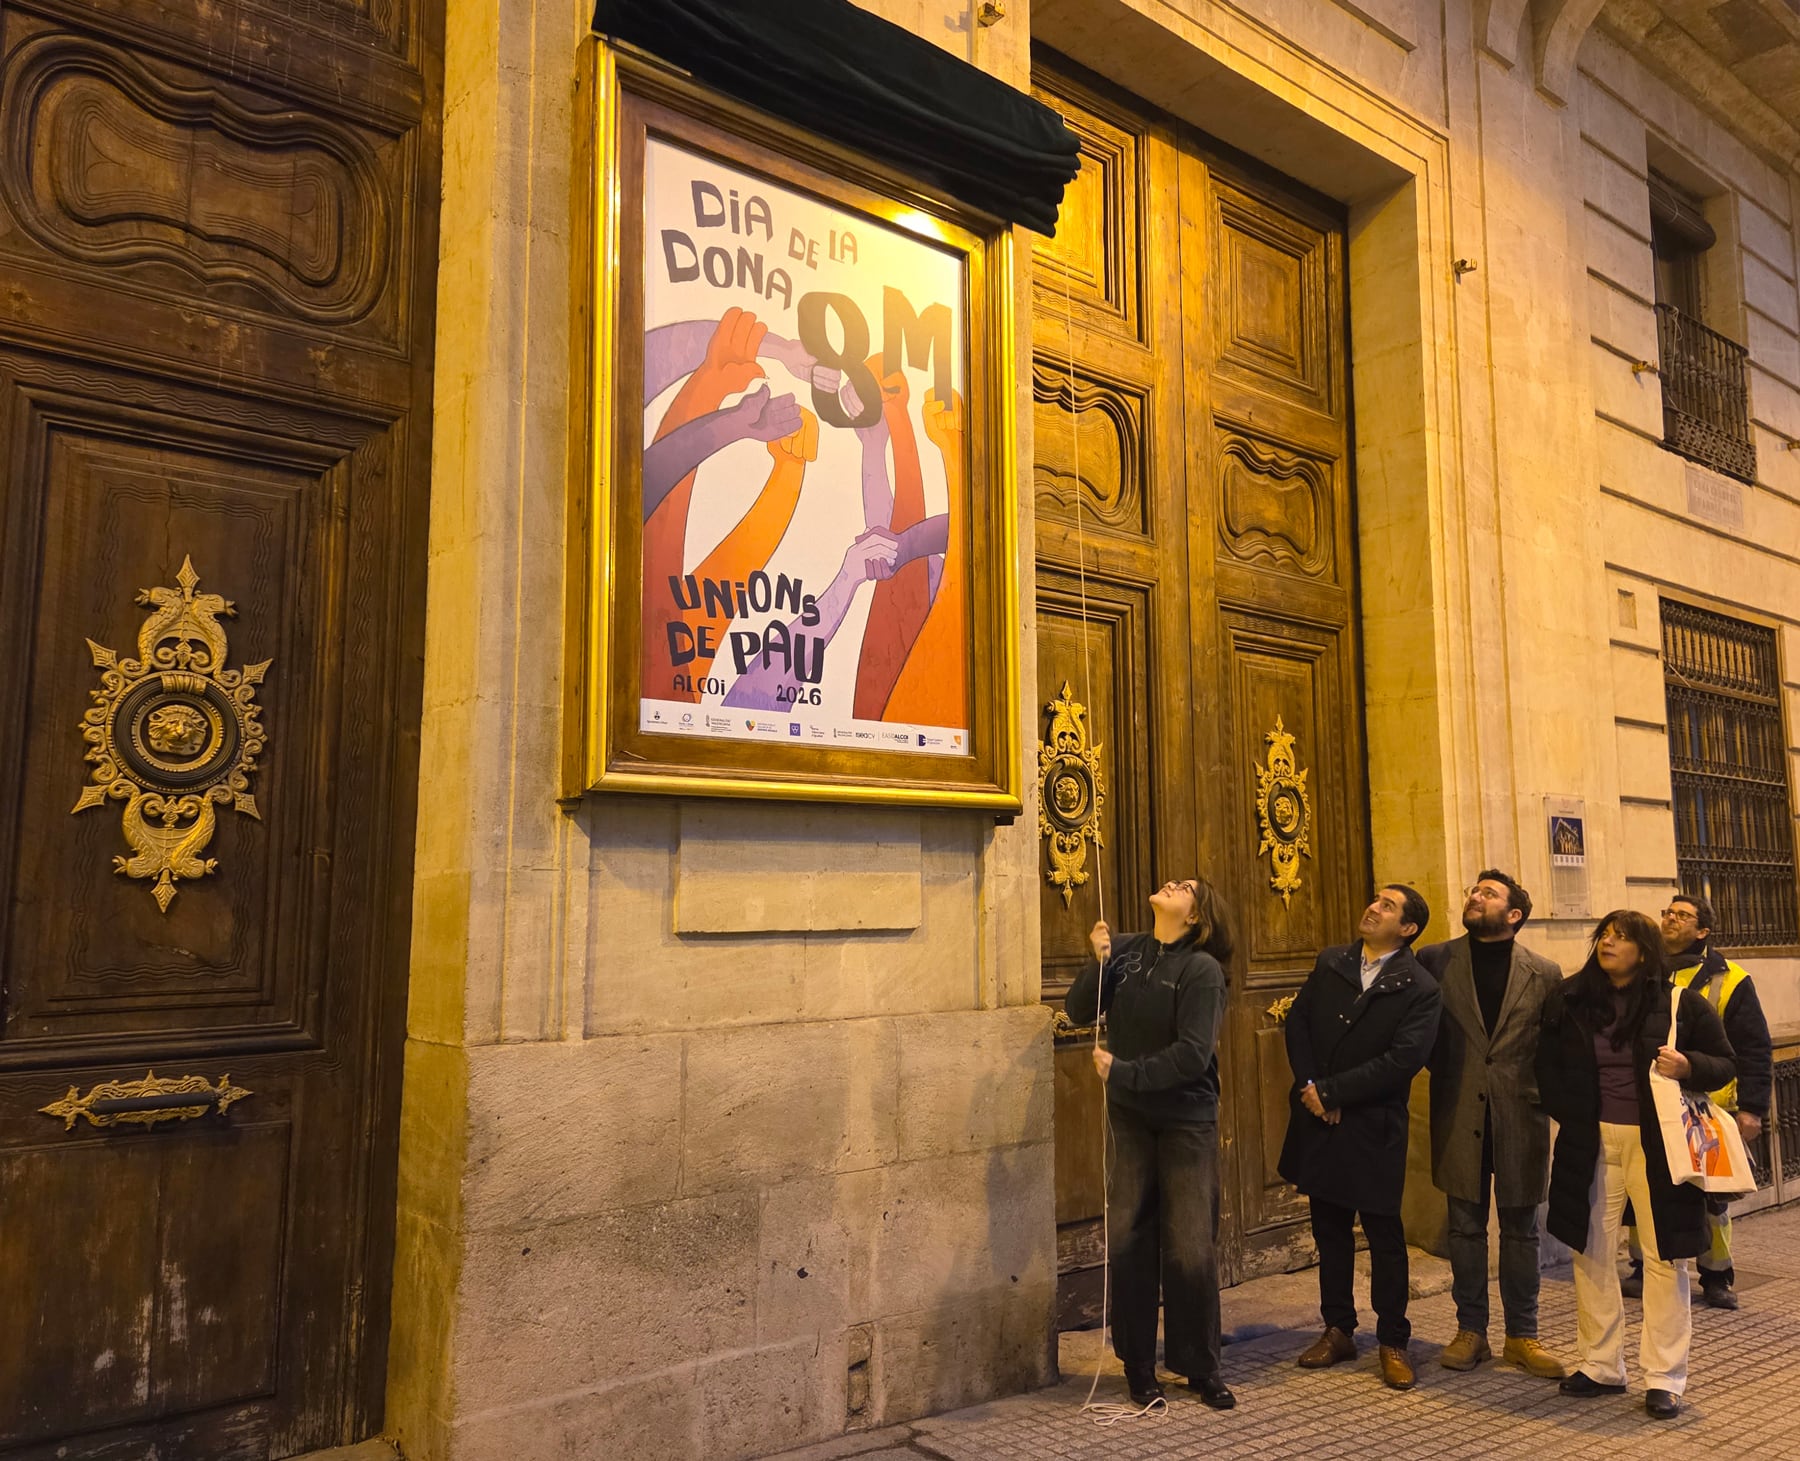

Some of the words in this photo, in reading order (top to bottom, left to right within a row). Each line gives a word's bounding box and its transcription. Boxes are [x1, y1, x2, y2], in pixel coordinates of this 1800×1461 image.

[661, 229, 792, 310] DONA
[788, 227, 820, 270] DE
[829, 230, 858, 265] LA
[798, 285, 952, 428] 8M
[666, 621, 716, 667] DE
[730, 620, 825, 684] PAU
[776, 684, 822, 705] 2026
